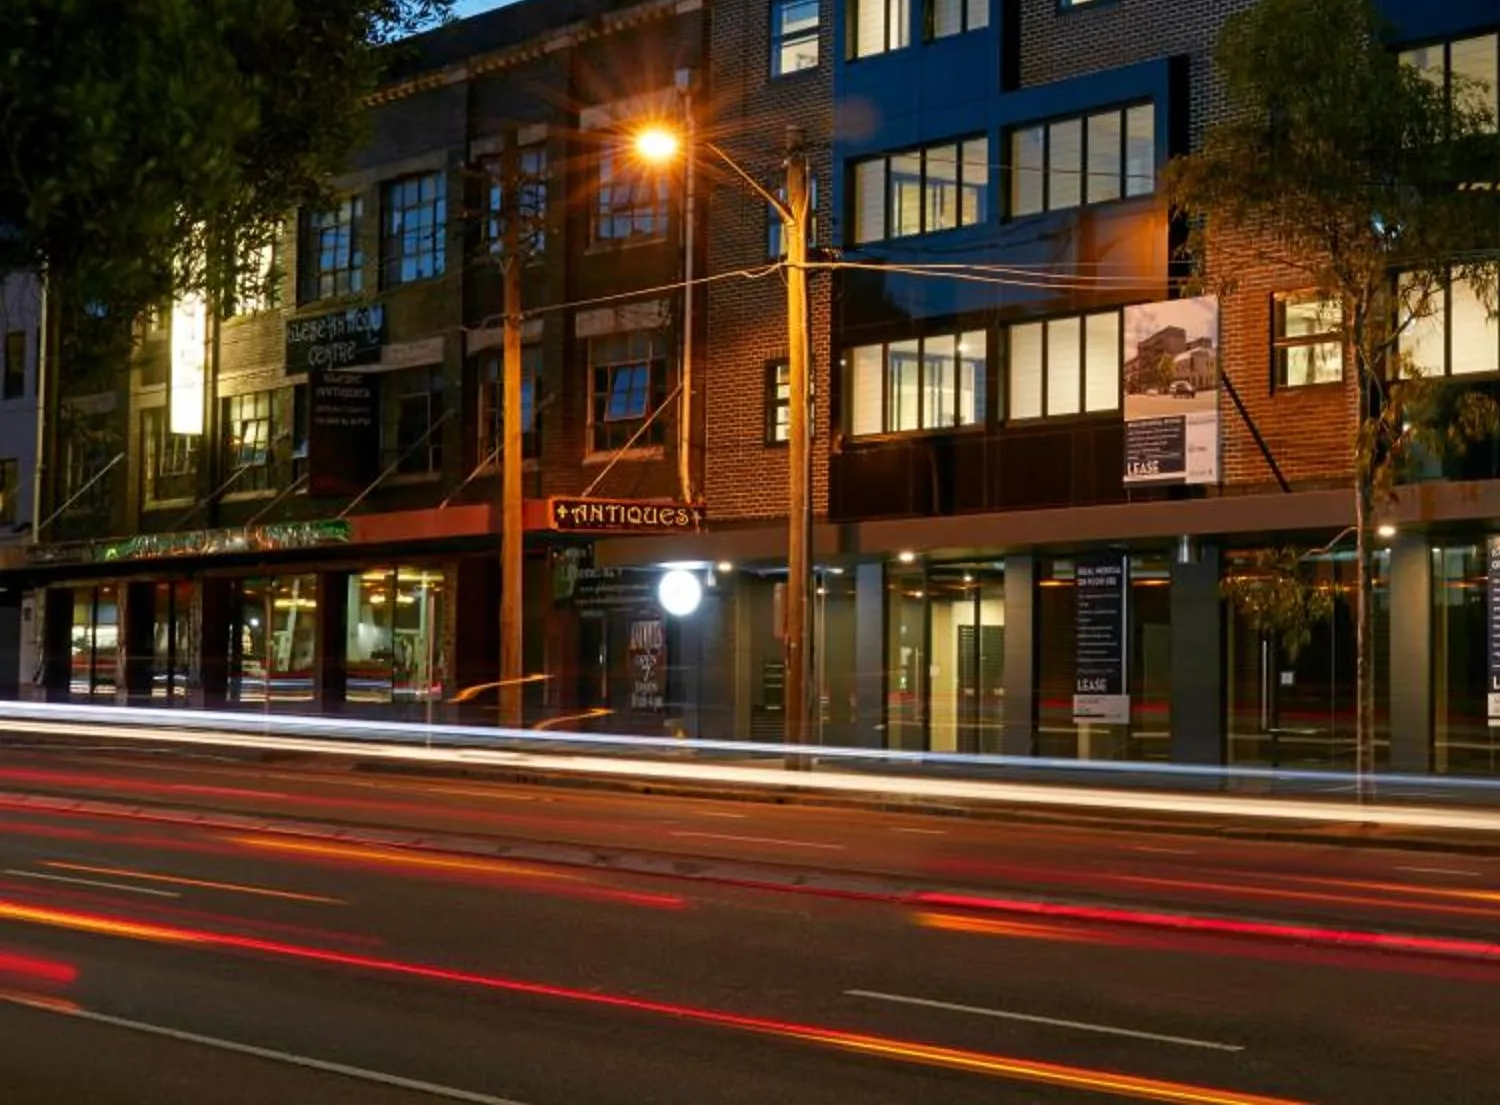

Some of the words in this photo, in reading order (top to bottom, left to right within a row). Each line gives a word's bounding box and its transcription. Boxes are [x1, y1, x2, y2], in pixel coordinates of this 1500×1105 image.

[1127, 460, 1160, 477] LEASE
[571, 503, 690, 527] ANTIQUES
[1077, 677, 1107, 693] LEASE
